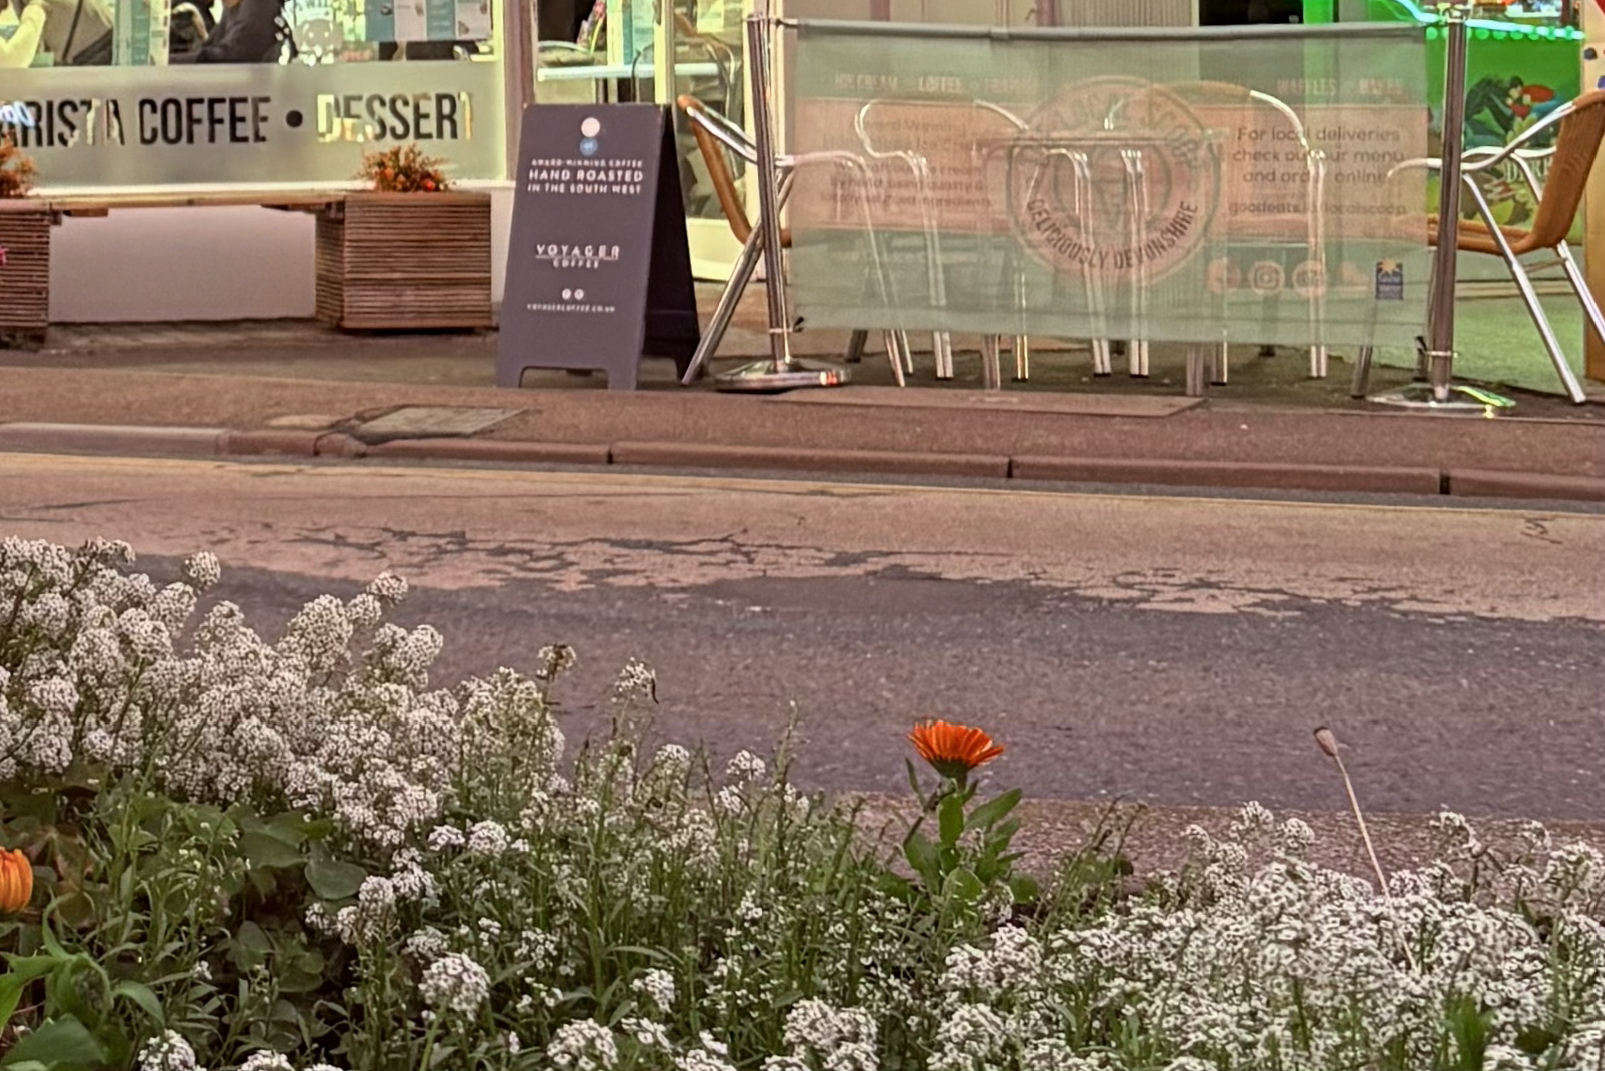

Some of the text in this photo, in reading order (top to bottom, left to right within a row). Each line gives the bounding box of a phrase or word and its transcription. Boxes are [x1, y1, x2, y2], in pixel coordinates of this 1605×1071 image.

[138, 95, 271, 146] COFFEE
[1237, 126, 1401, 144] For locl deliveries
[1232, 148, 1281, 162] check
[1286, 150, 1308, 162] ou
[1354, 152, 1405, 162] menu
[529, 169, 643, 183] HAND ROASTED
[1244, 169, 1276, 182] and
[1281, 169, 1316, 182] ord
[527, 182, 642, 195] IN THE SOUTH WEST
[1027, 198, 1108, 270] DELICIOUSLY
[536, 243, 620, 261] VOYAGER
